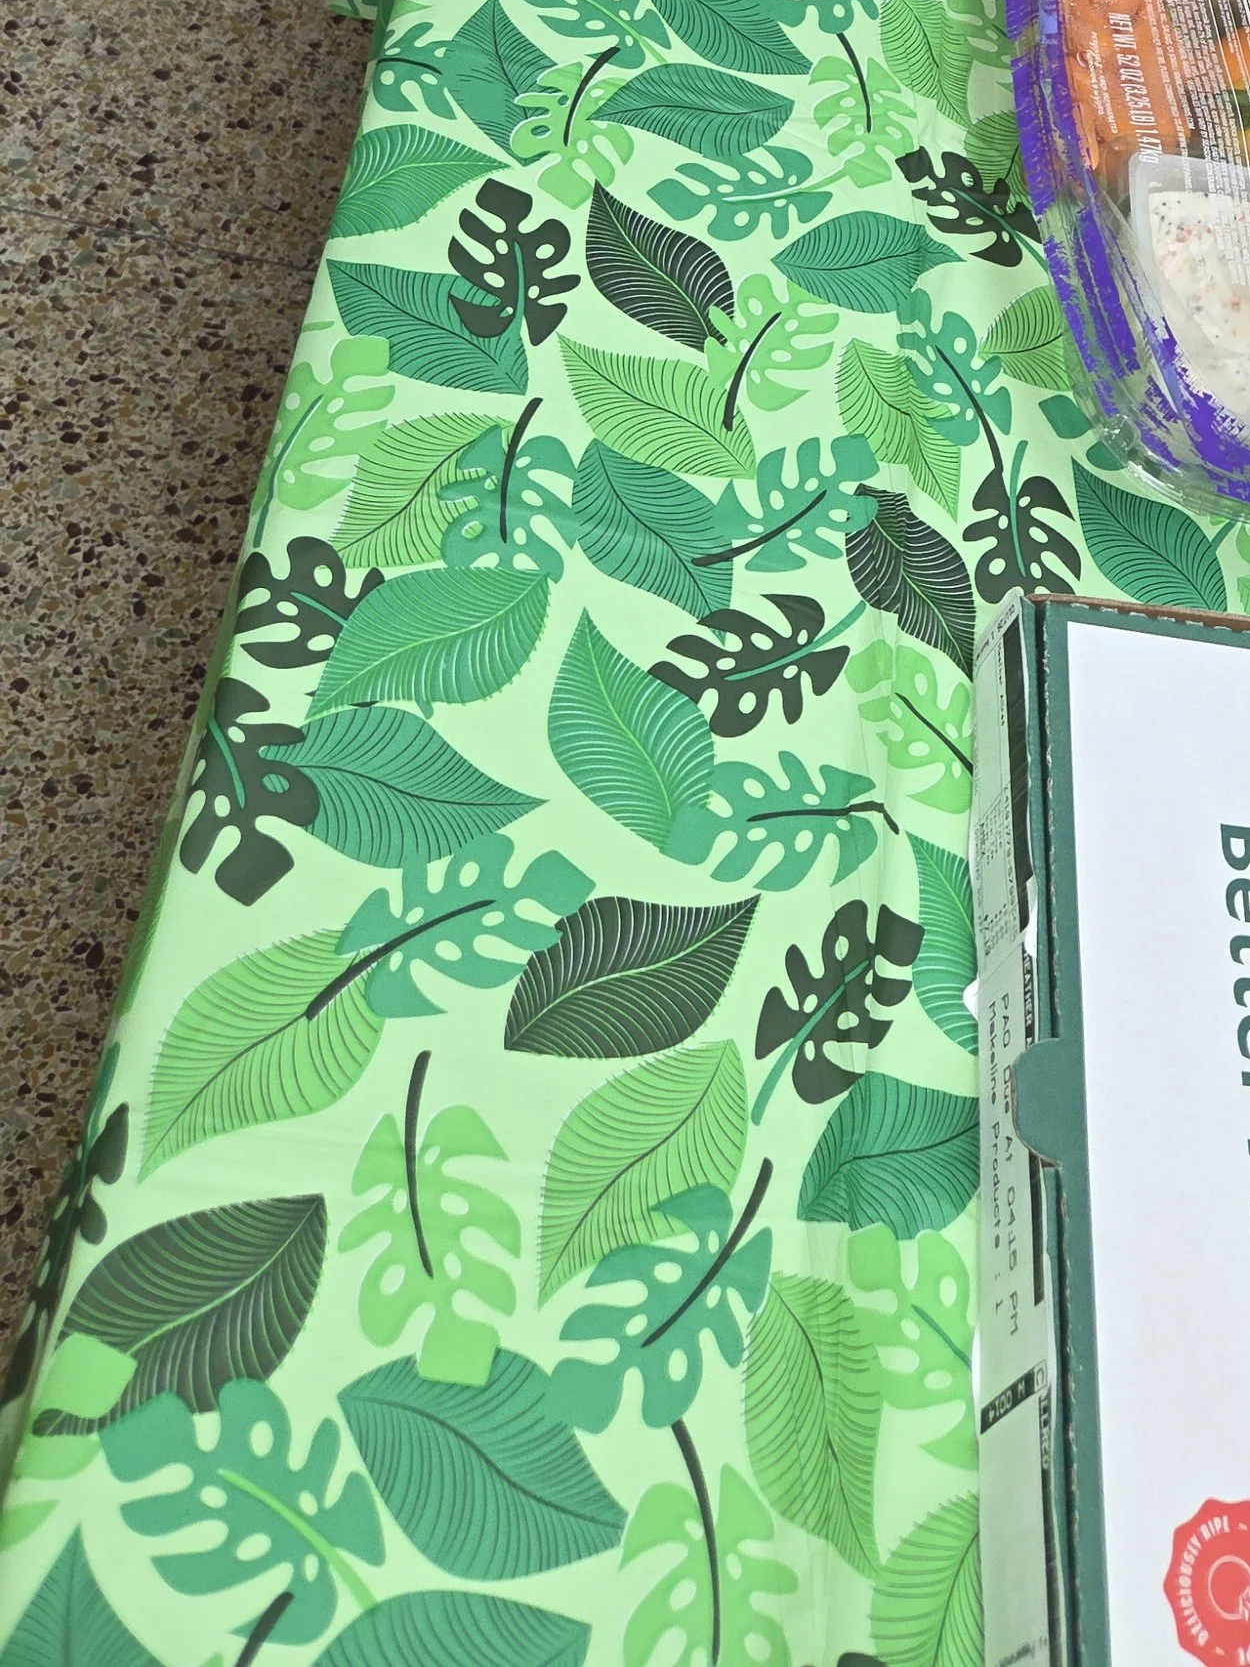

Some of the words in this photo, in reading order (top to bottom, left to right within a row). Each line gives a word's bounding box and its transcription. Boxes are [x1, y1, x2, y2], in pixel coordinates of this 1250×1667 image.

[1108, 12, 1133, 33] NET
[1112, 32, 1138, 53] WT.
[1117, 53, 1142, 67] 52
[1120, 67, 1144, 83] OZ
[1120, 83, 1152, 109] (3.25
[1128, 108, 1157, 127] LB)
[988, 1002, 998, 1107] Makeline
[991, 1120, 1001, 1250] Products
[1003, 1065, 1012, 1115] Due
[1009, 1290, 1019, 1336] PM
[1178, 1533, 1209, 1647] DELICIOUSLY
[1200, 1515, 1231, 1541] RIPE
